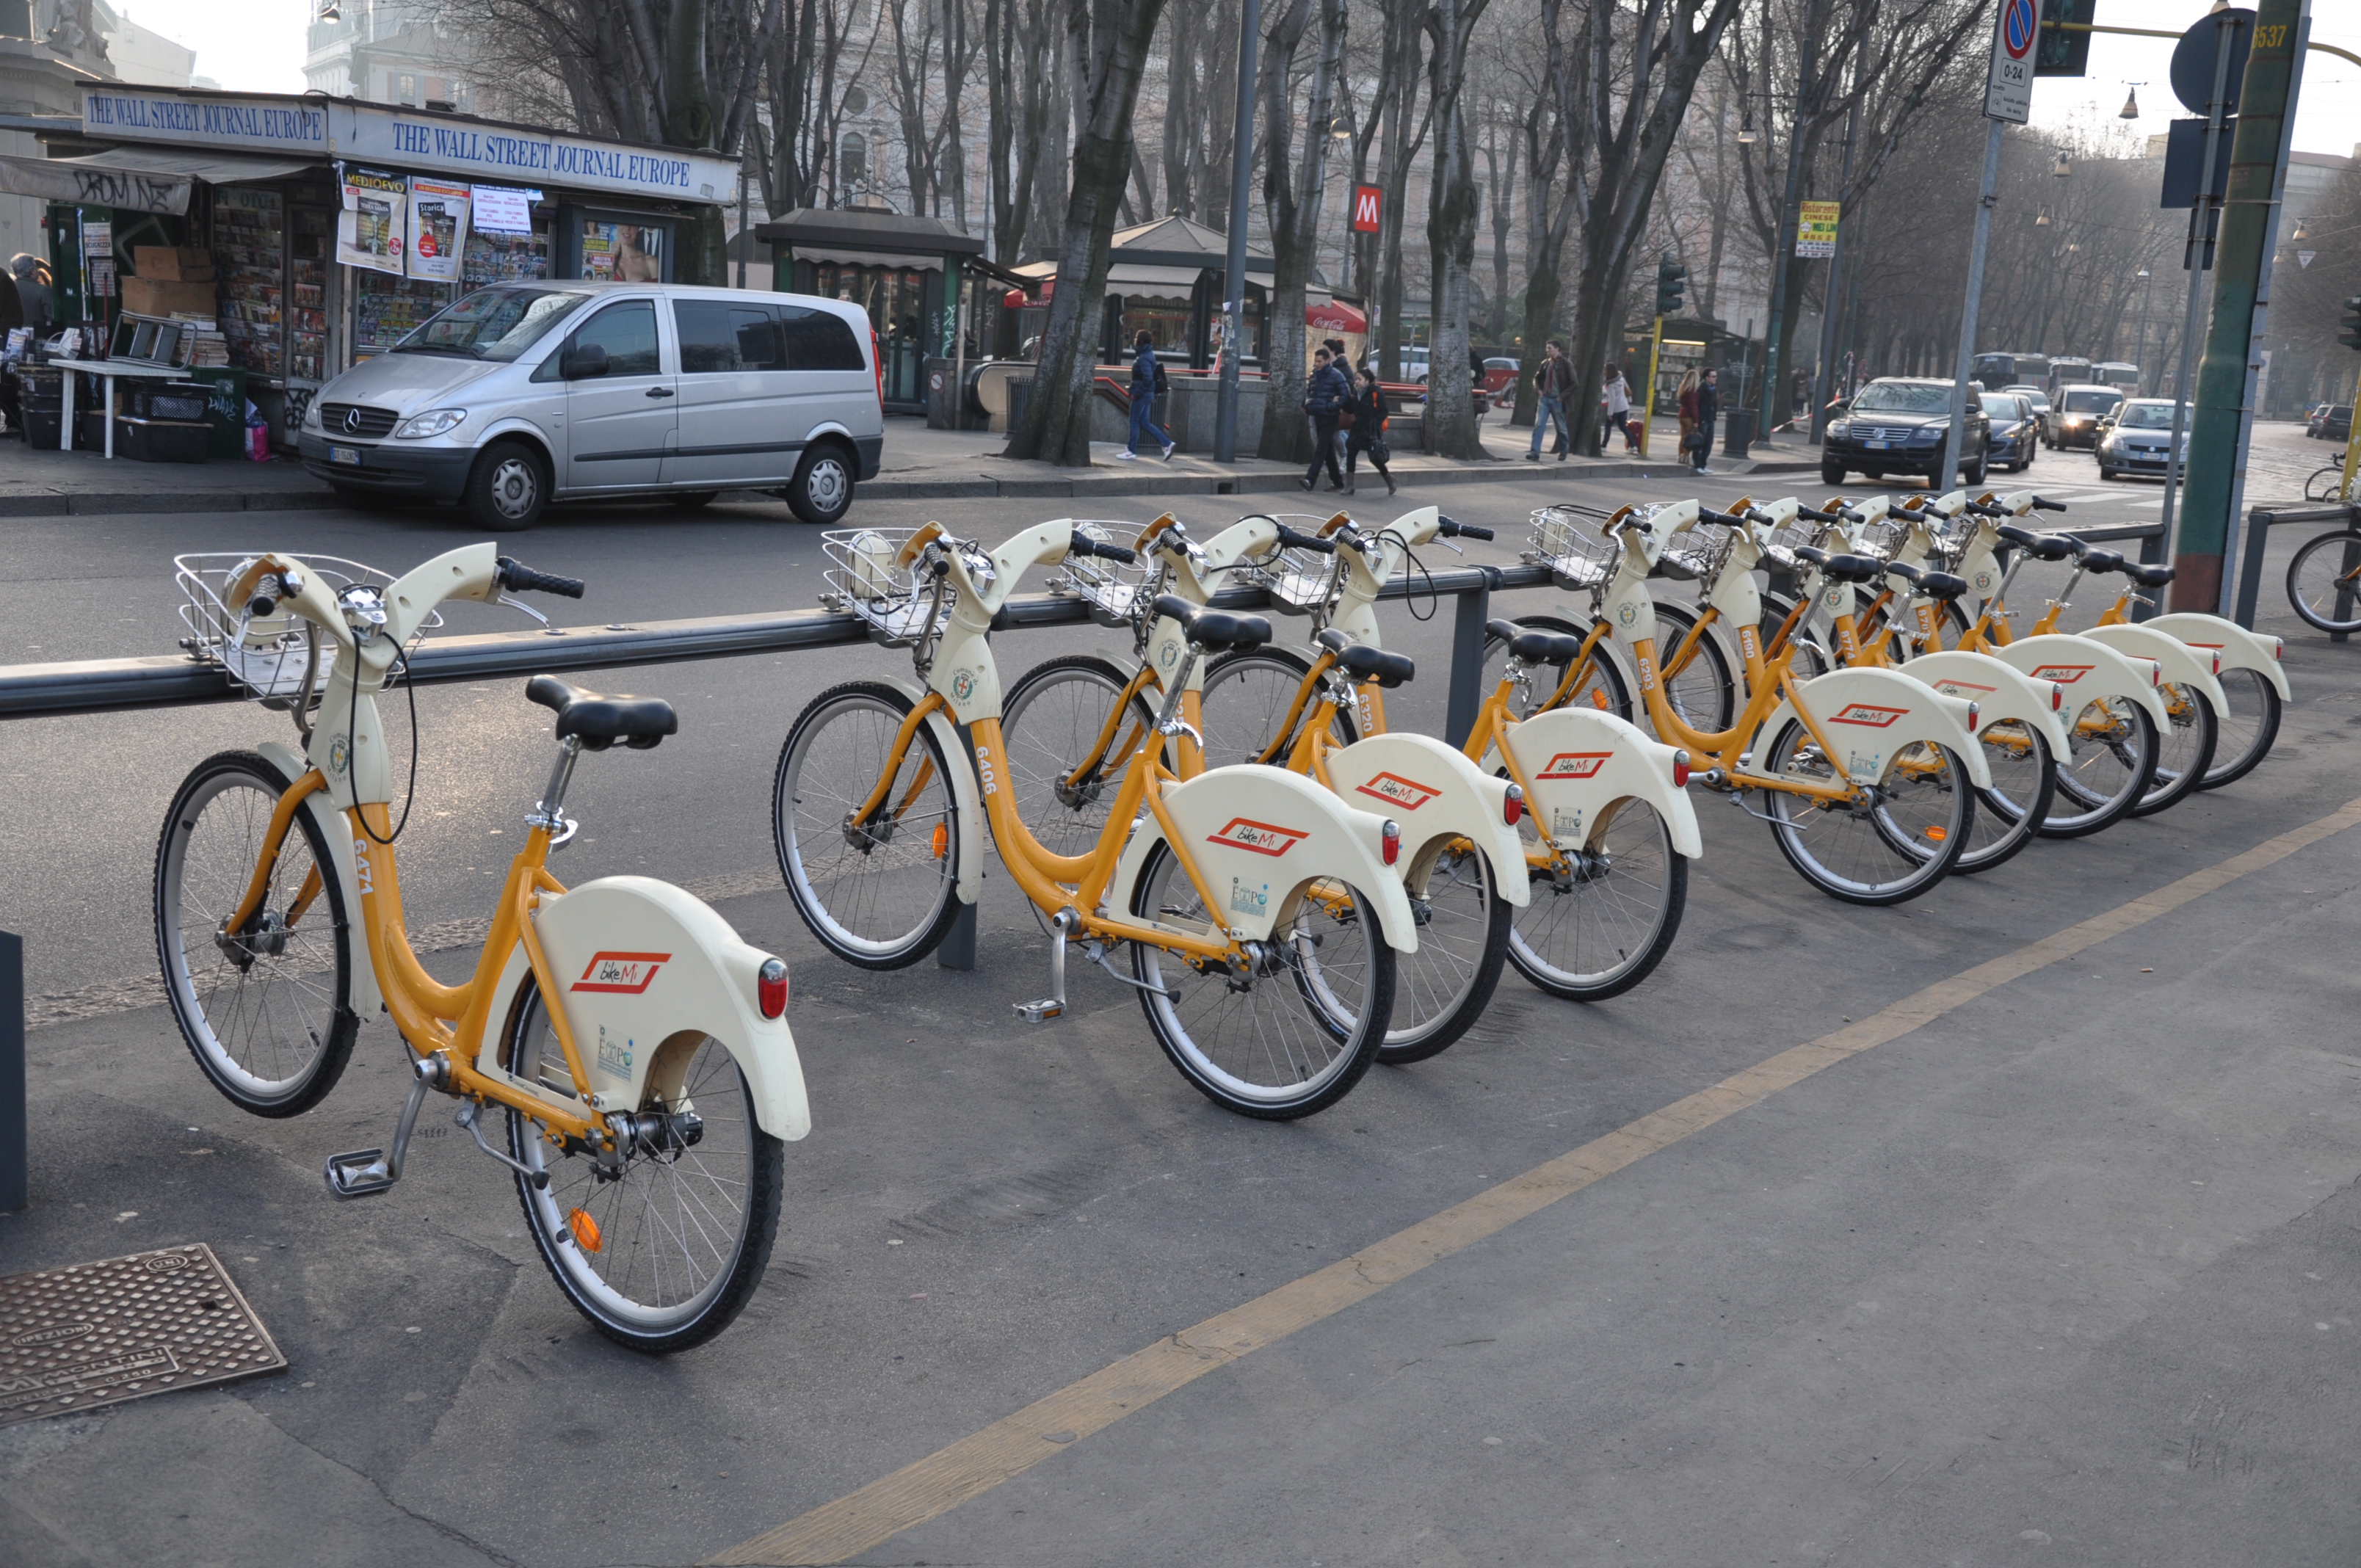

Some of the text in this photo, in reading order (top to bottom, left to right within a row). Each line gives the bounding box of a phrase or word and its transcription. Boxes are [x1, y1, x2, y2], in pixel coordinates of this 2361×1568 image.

[2004, 64, 2023, 81] 0-24
[88, 96, 322, 140] THE WALL STREET JOURNAL EUROPE
[393, 123, 690, 187] THE WALL STREET JOURNAL EUROPE
[347, 173, 405, 192] MEDIOEVO
[420, 203, 444, 211] Storica
[1357, 195, 1378, 223] M
[1802, 202, 1839, 214] Ristorante
[1313, 316, 1346, 331] Coca-Cola
[1742, 630, 1755, 658] 6190
[1841, 631, 1857, 660] 8774
[953, 667, 978, 686] Comune di
[1639, 658, 1655, 691] 6293
[950, 692, 971, 707] Milano
[1360, 694, 1373, 733] 6320
[1852, 709, 1883, 722] bikeMi
[327, 764, 347, 783] Milano
[977, 746, 997, 795] 6406
[1559, 759, 1589, 772] bikeMi
[1381, 780, 1414, 802] bikeMi
[1237, 827, 1276, 848] bikeMi
[355, 839, 374, 895] 6471
[600, 962, 638, 984] bikeMi
[153, 1257, 181, 1269] UNI
[17, 1324, 90, 1344] ISPEZIONE
[40, 1349, 163, 1379] MONTINI
[120, 1369, 151, 1380] 250
